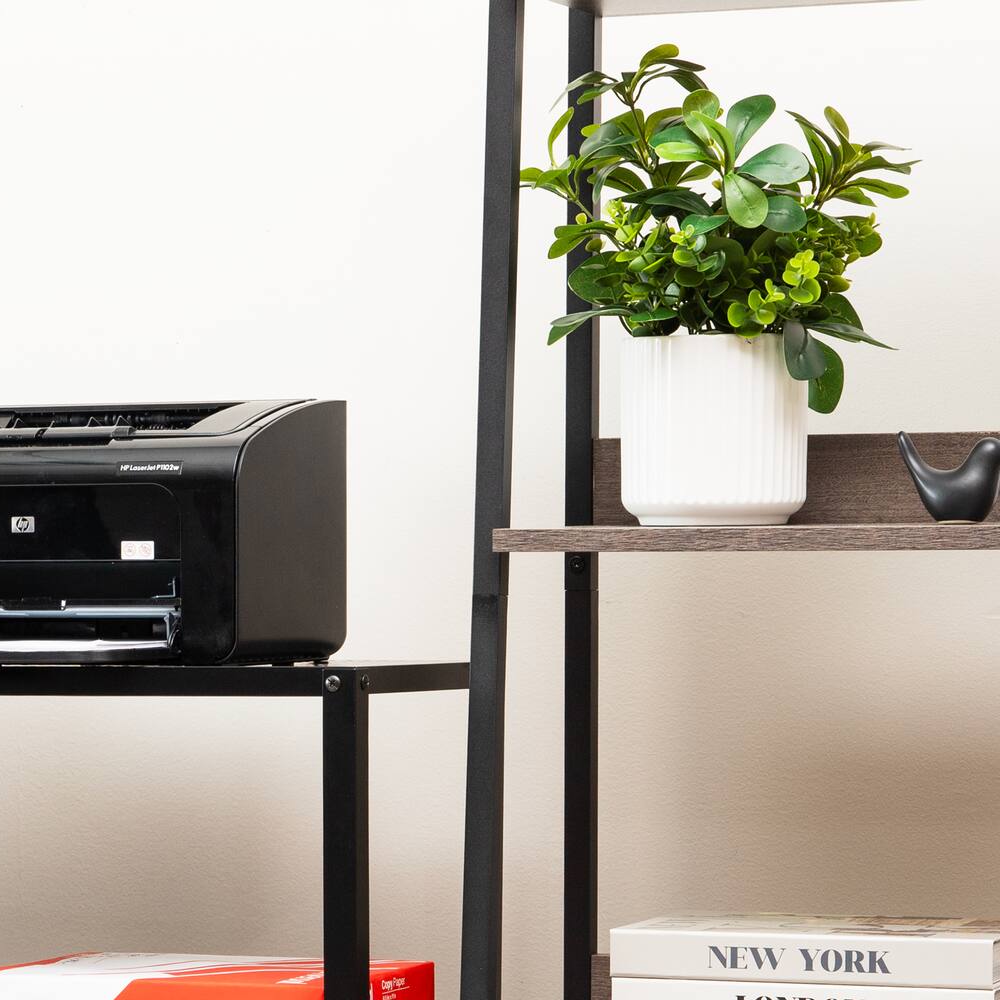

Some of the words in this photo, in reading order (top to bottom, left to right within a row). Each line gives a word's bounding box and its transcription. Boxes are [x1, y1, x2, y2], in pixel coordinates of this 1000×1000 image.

[156, 463, 180, 471] P1102w
[708, 945, 786, 970] NEW
[799, 948, 891, 974] YORK
[381, 979, 393, 991] Copy
[393, 977, 405, 988] Paper
